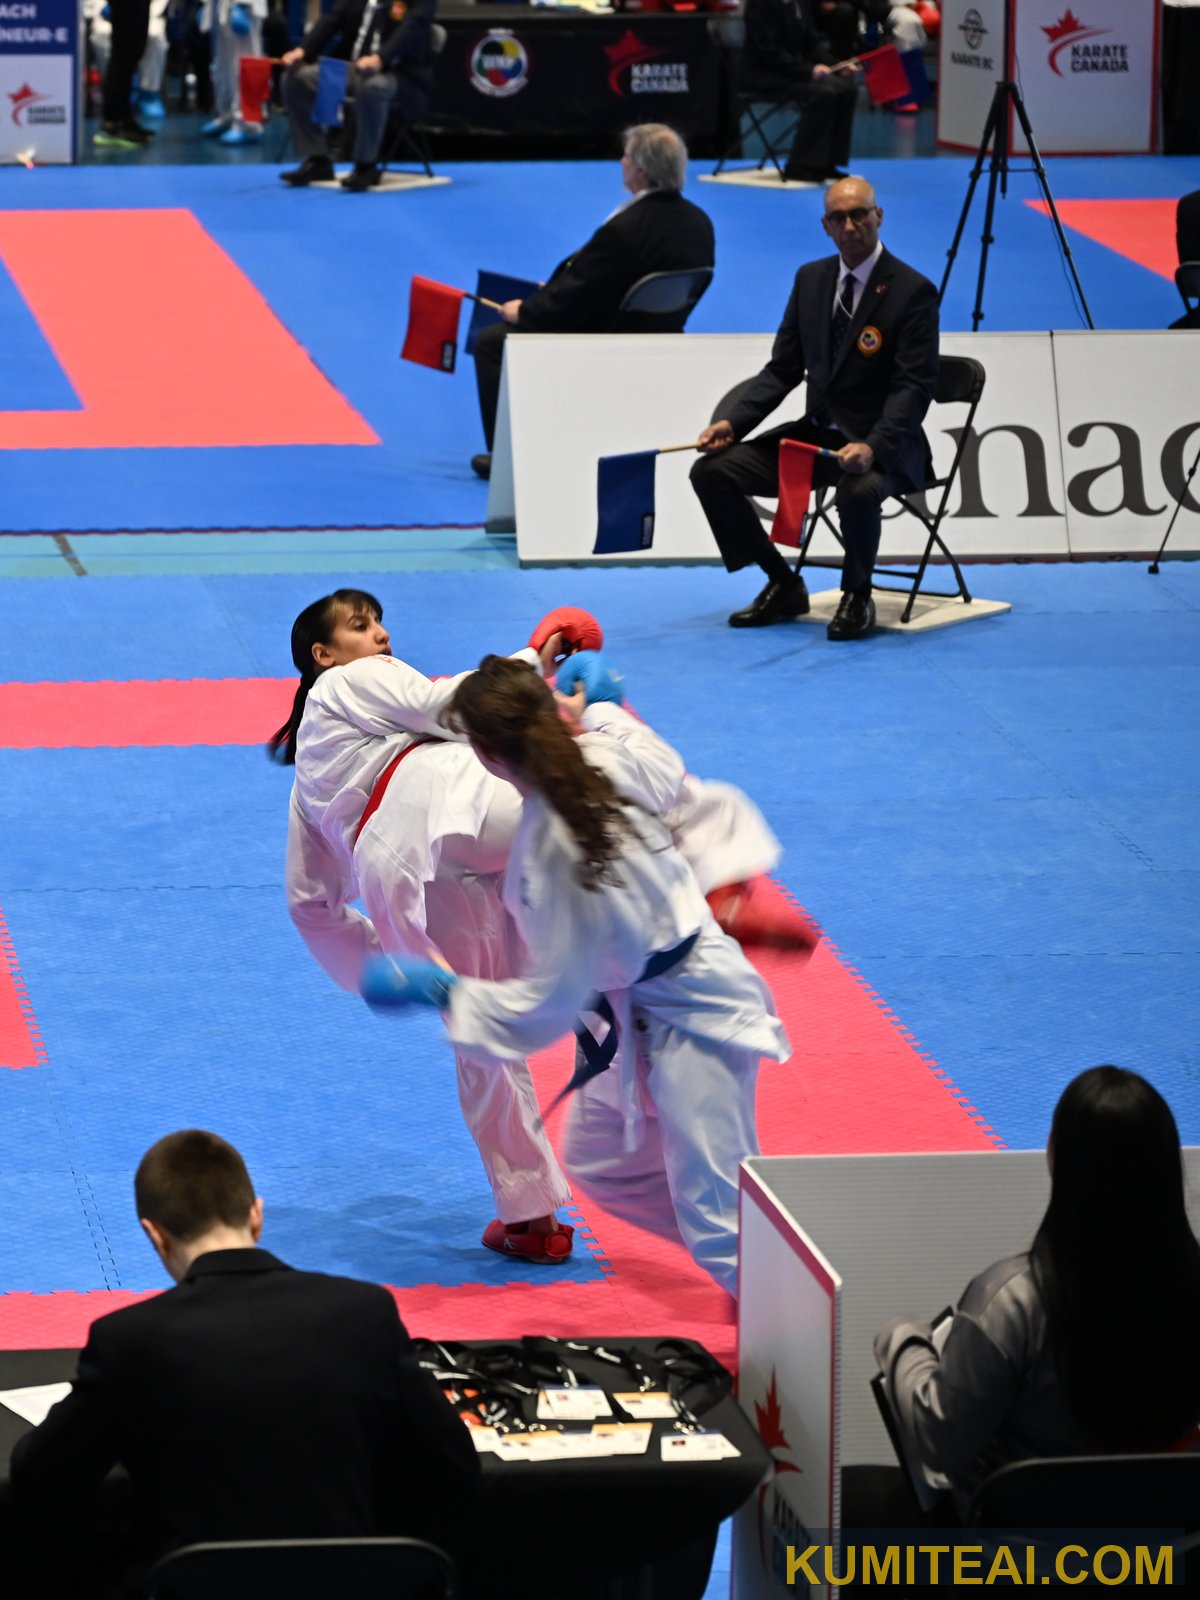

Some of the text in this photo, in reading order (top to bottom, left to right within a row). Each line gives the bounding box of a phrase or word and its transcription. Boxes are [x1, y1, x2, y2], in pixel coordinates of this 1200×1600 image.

[1071, 44, 1128, 57] KARATE
[631, 63, 688, 77] KARATE
[1071, 59, 1129, 73] CANADA
[631, 78, 689, 93] CANADA
